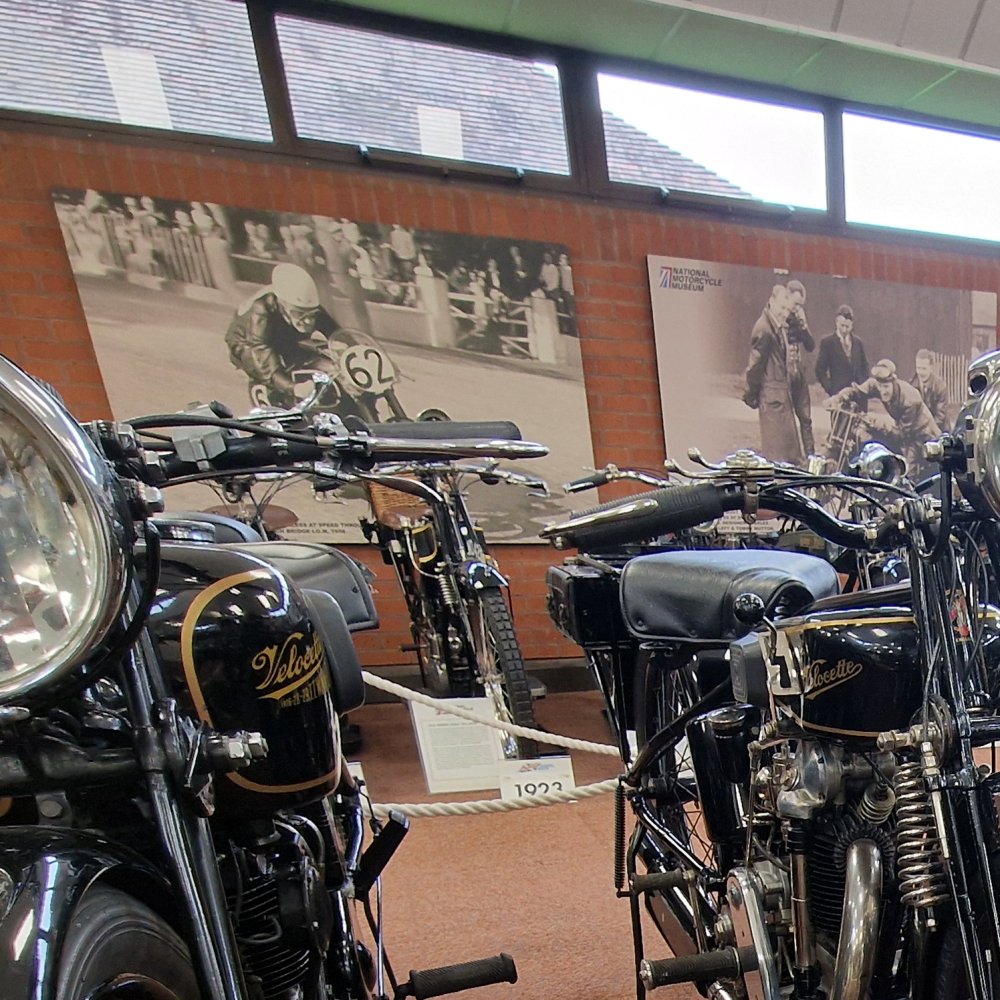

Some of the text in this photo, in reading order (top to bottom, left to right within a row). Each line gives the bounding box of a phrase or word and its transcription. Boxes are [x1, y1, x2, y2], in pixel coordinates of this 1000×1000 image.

[673, 267, 710, 278] NATIONAL
[672, 275, 722, 287] MOTORCYCLE
[672, 282, 705, 292] MUSEUM
[345, 348, 394, 390] 62
